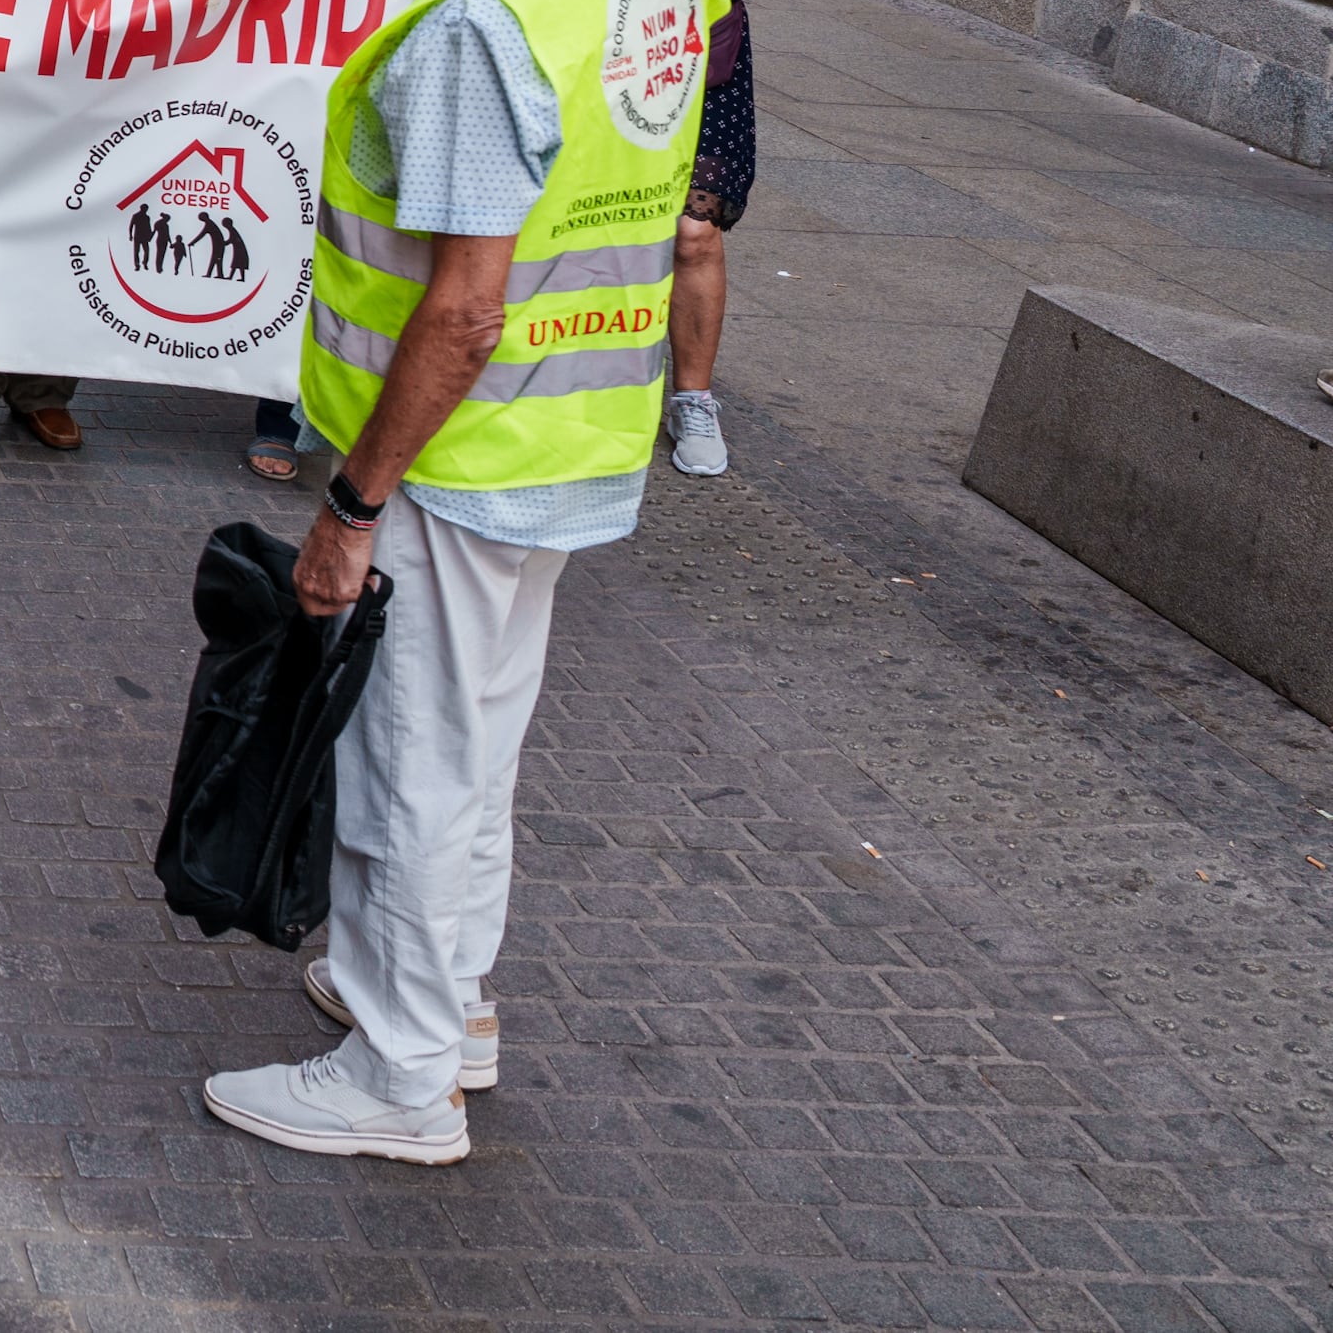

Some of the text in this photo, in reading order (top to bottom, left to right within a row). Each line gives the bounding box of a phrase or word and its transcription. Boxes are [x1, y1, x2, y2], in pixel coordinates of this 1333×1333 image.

[642, 6, 677, 42] NI UN
[605, 54, 634, 70] CGPM
[646, 36, 680, 70] PASO
[602, 66, 639, 85] UNIDAD
[66, 99, 315, 225] Coordinadora Estatal por la Defensa
[161, 179, 231, 195] UNIDAD
[161, 192, 230, 211] COESPE
[69, 244, 313, 359] del Sistema Público de Pensiones
[528, 307, 653, 347] UNIDAD
